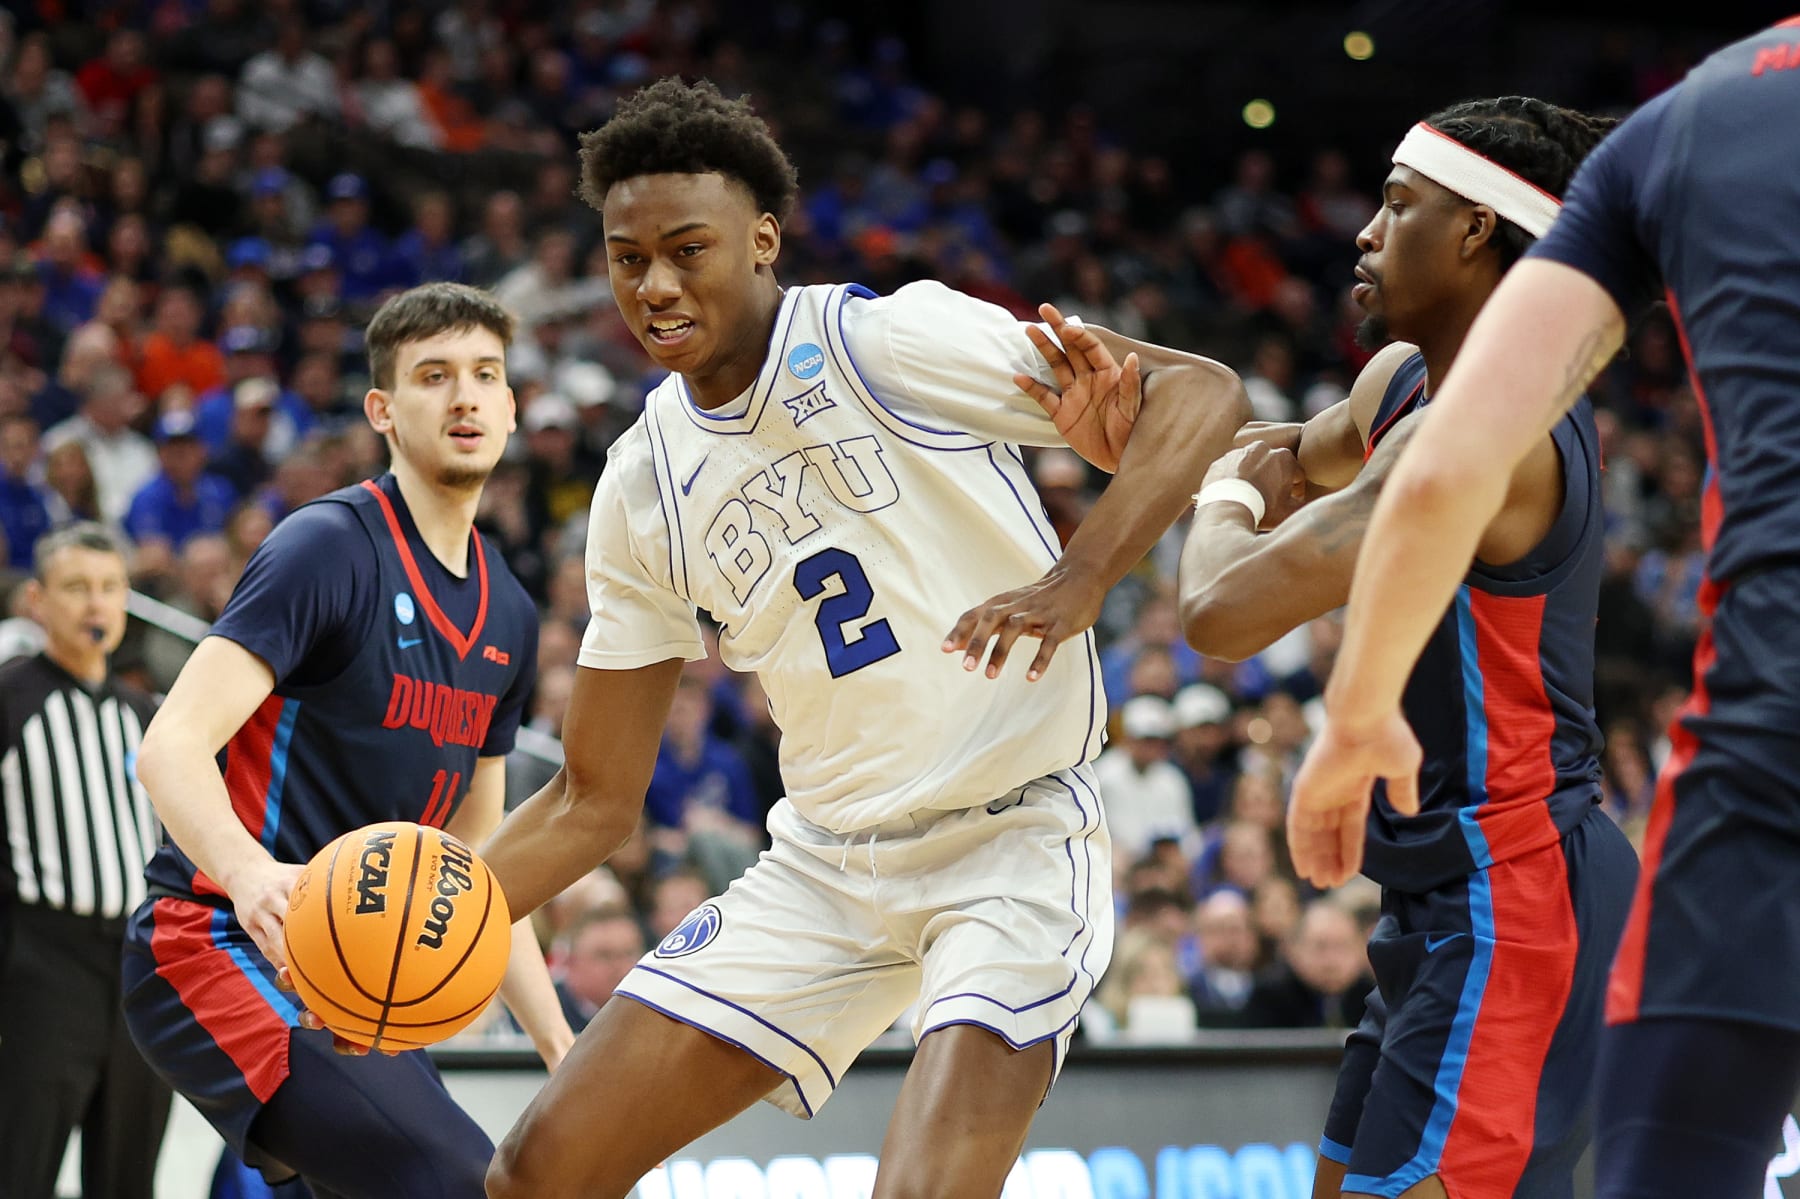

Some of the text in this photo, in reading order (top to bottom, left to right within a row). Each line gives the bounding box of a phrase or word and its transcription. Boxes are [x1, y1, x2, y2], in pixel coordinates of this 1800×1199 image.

[793, 353, 823, 373] NCAA
[704, 435, 900, 608] BYU
[793, 547, 902, 679] 2
[356, 831, 397, 914] NCAA
[417, 833, 473, 949] Wilson
